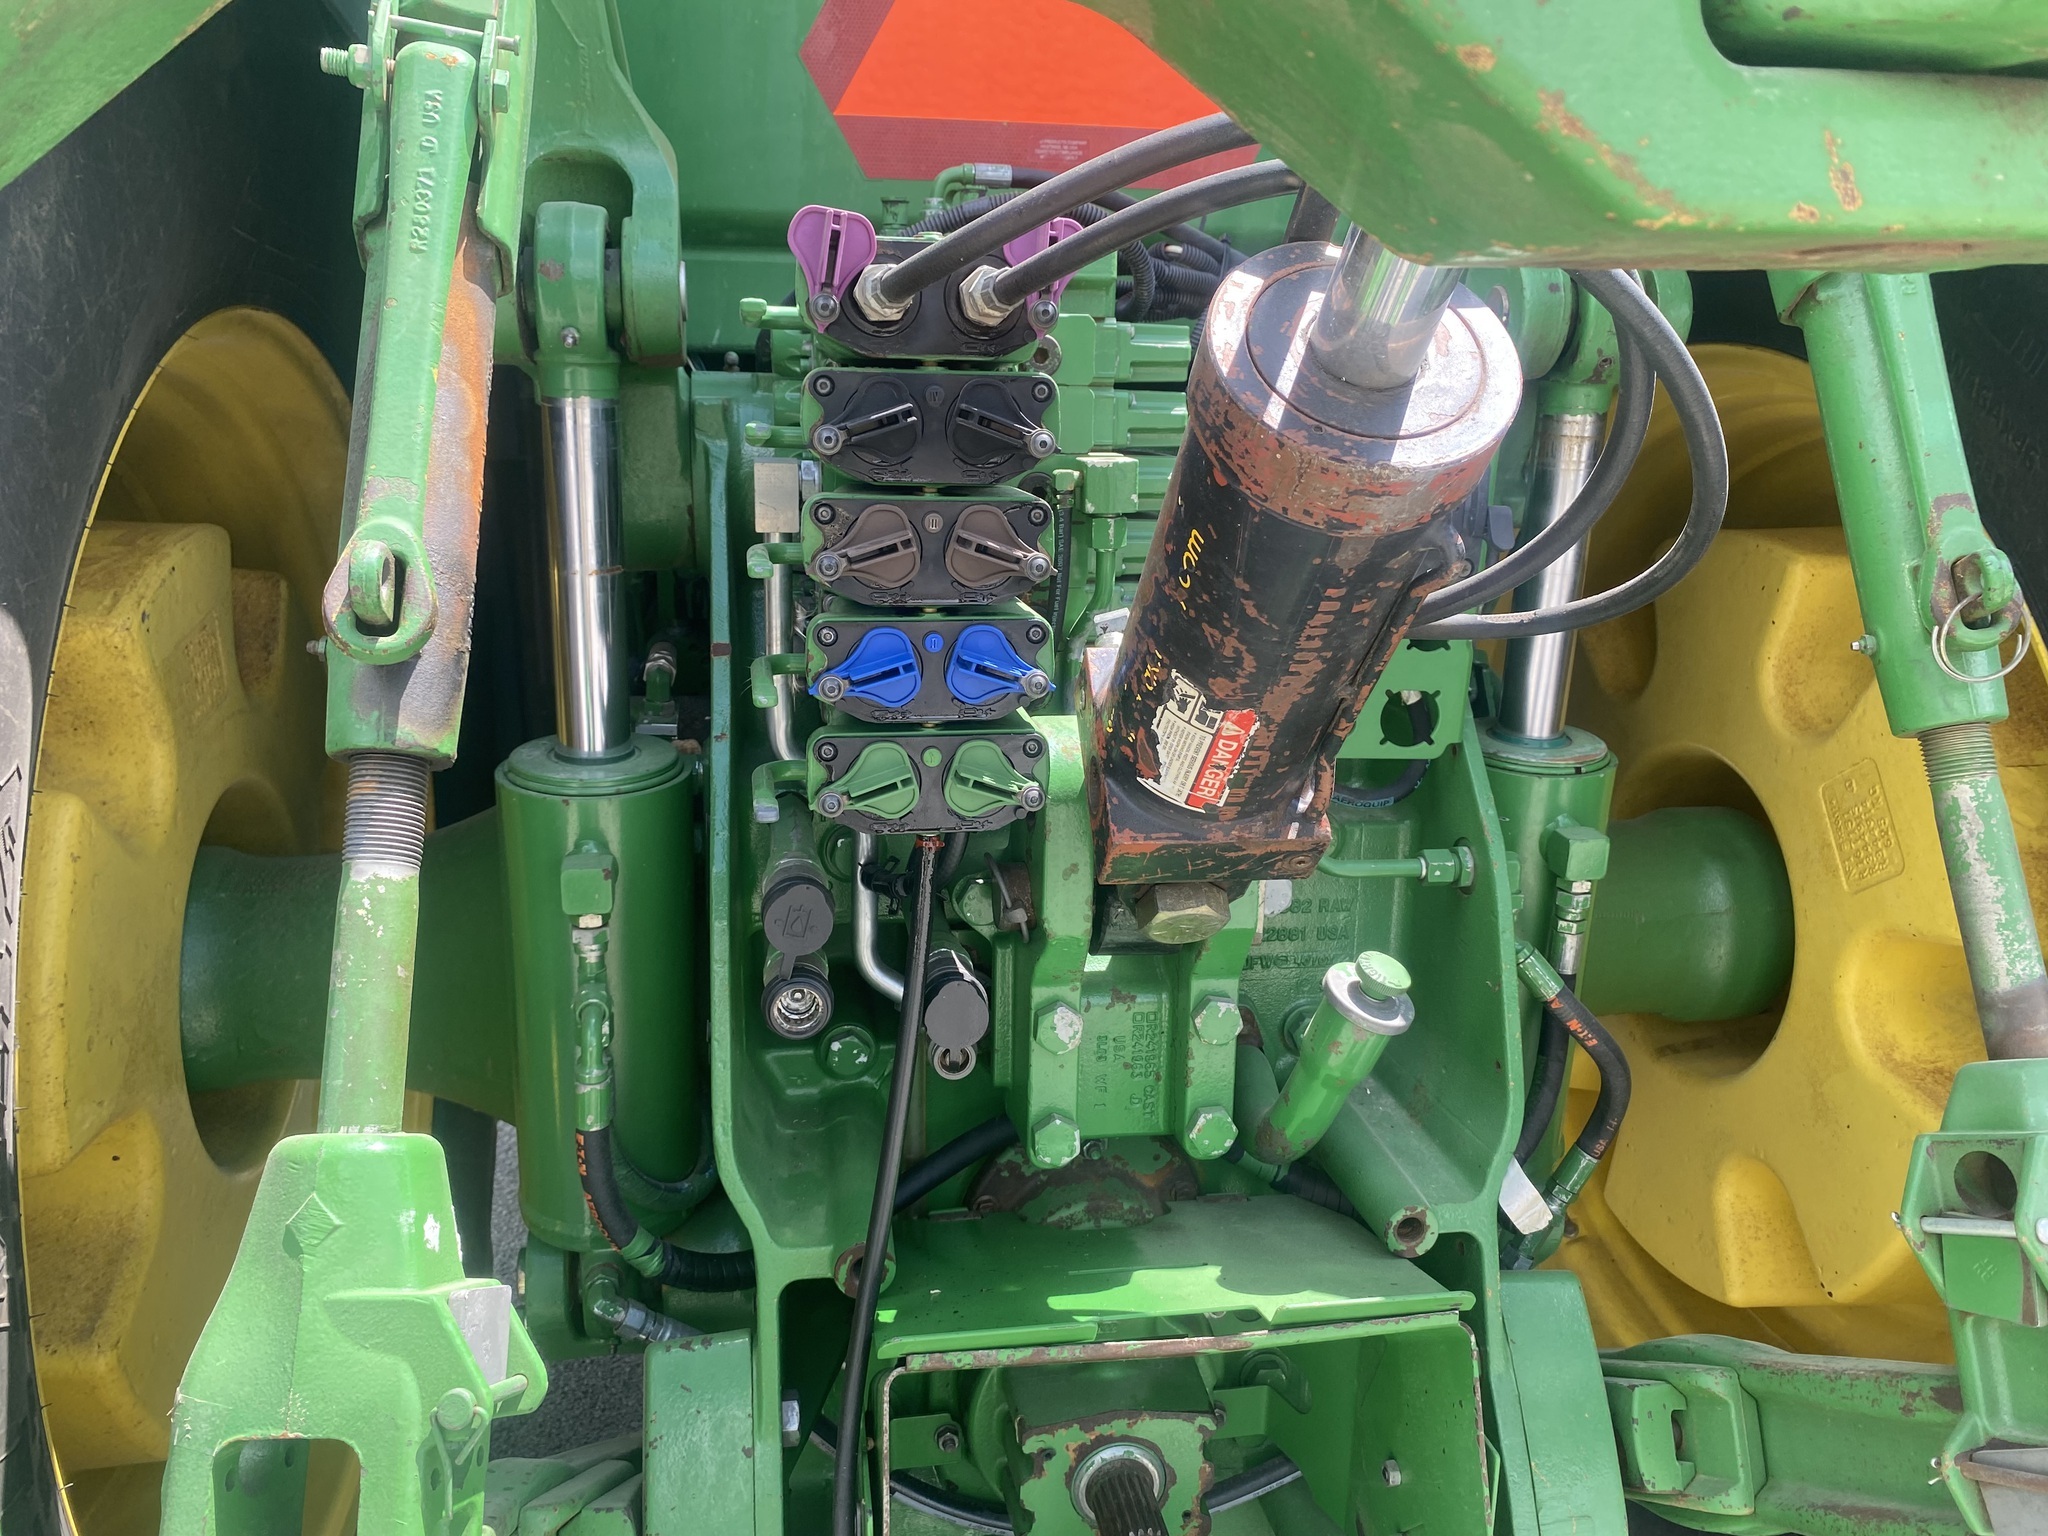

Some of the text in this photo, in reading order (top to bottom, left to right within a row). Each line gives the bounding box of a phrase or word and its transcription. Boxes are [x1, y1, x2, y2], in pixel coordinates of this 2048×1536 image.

[1196, 740, 1234, 796] DANGER
[1333, 795, 1390, 807] AEROQUIP
[1318, 899, 1354, 913] RAW
[1317, 926, 1349, 940] USA
[1112, 1036, 1124, 1062] USA
[1142, 1085, 1153, 1118] CAST
[1591, 1136, 1609, 1158] USA
